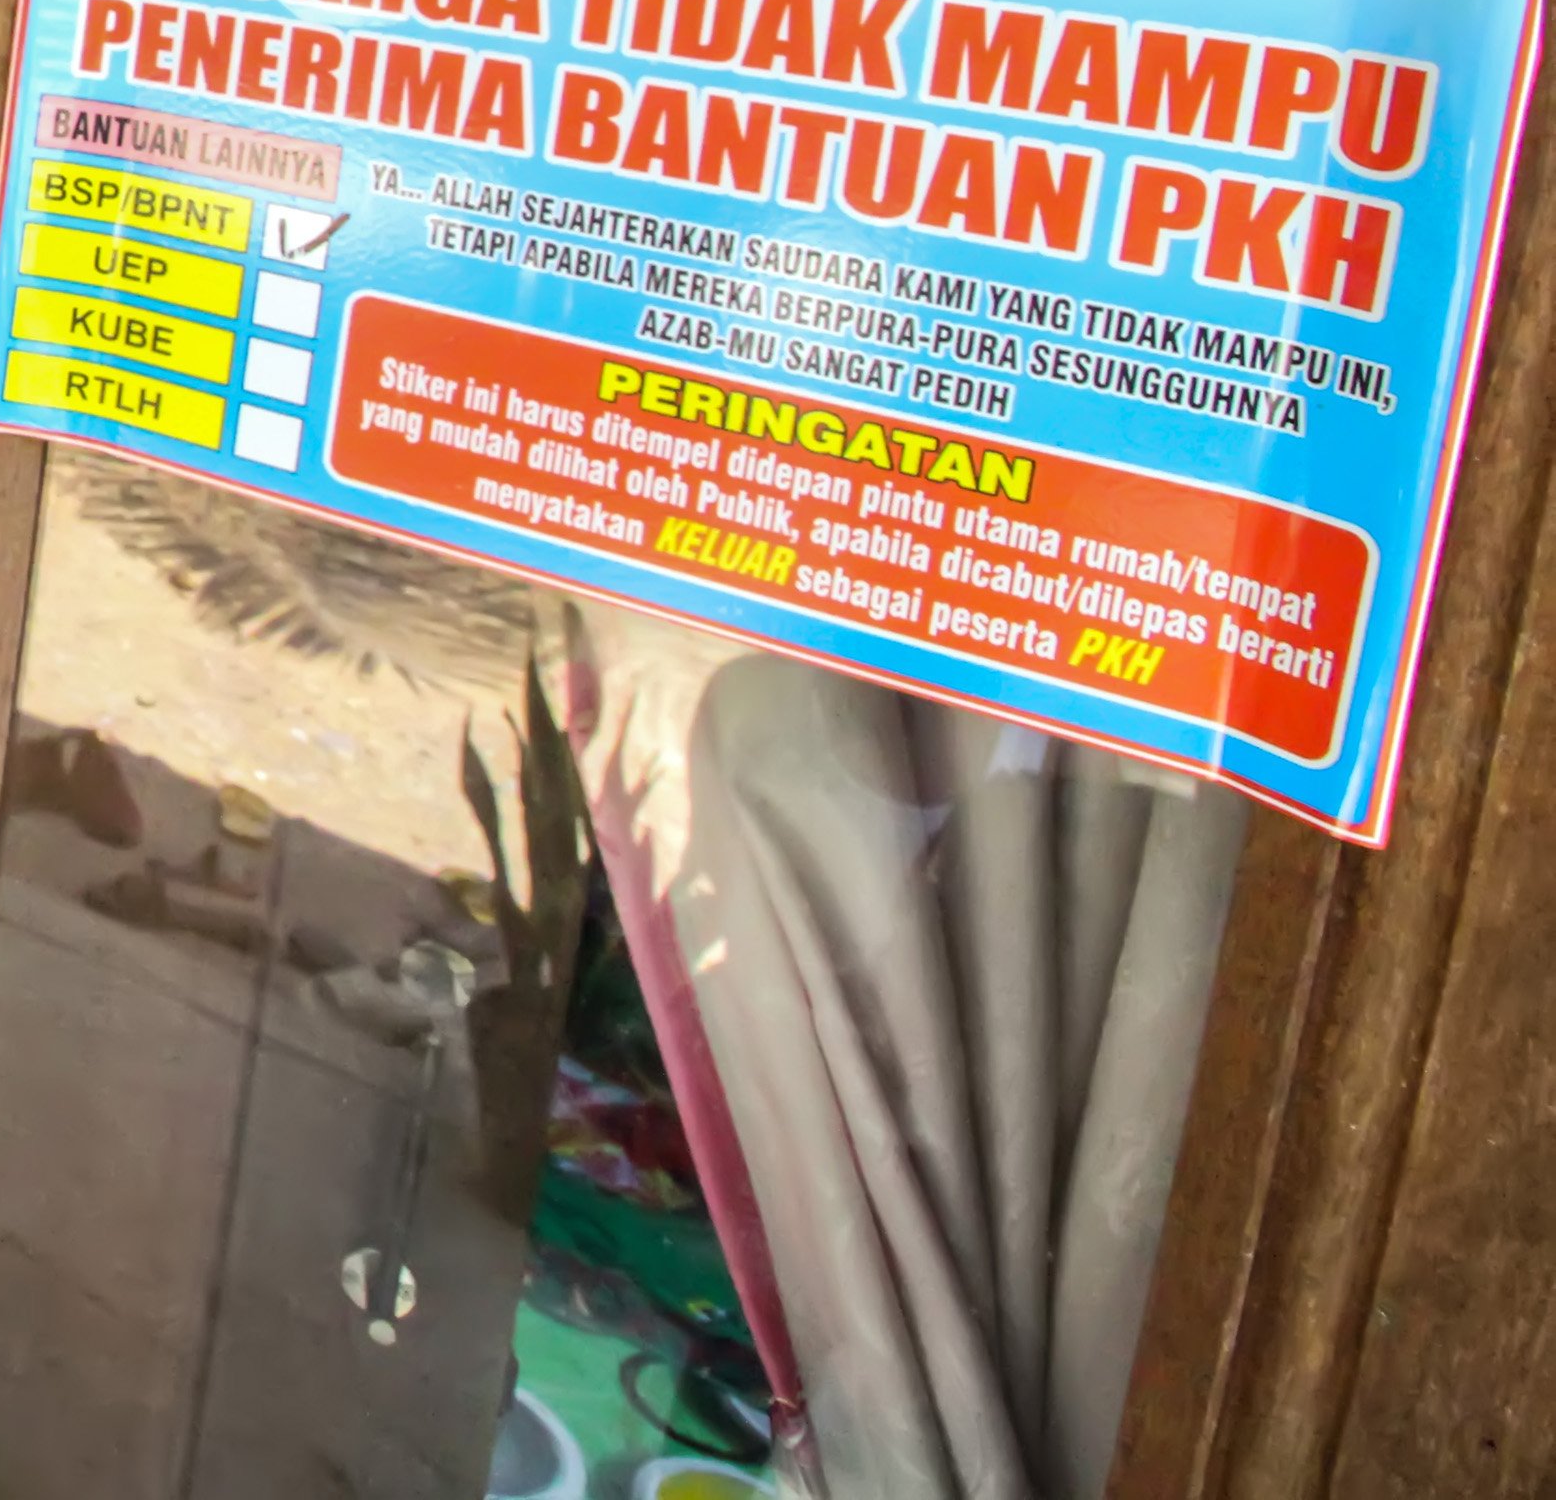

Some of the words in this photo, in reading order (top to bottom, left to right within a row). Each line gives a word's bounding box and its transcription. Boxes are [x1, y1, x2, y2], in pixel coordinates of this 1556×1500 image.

[53, 108, 189, 161] BANTUAN
[200, 134, 326, 190] LAINNYA
[929, 3, 1433, 175] MAMPU
[44, 173, 235, 233] BSP/BPNT
[92, 250, 168, 283] UEP
[554, 73, 1104, 253] BANTUAN
[1120, 172, 1393, 314] PKH
[70, 310, 174, 355] KUBE
[373, 164, 422, 199] YA...
[432, 178, 513, 216] ALLAH
[521, 195, 735, 261] SEJAHTERAKAN
[745, 238, 883, 292] SAUDARA
[895, 267, 976, 312] KAMI
[989, 285, 1071, 330] YANG
[1085, 304, 1183, 353] TIDAK
[1193, 327, 1329, 385] MAMPU
[1338, 356, 1392, 409] INI,
[428, 219, 514, 260] TETAPI
[523, 240, 634, 288] APABILA
[645, 265, 763, 315] MEREKA
[774, 291, 1018, 370] BERPURA-PURA
[1030, 346, 1301, 432] SESUNGGUHNYA
[641, 310, 776, 364] AZAB-MU
[787, 341, 904, 392] SANGAT
[911, 368, 1009, 417] PEDIH
[65, 373, 161, 420] RTLH
[598, 361, 1035, 502] PERINGATAN
[360, 399, 422, 443] yang
[430, 414, 520, 462] mudah
[528, 438, 619, 489] dilihat
[626, 467, 688, 509] oleh
[697, 480, 800, 544] Publik,
[810, 516, 929, 572] apabila
[940, 548, 1206, 645] dicabut/dilepas
[1218, 614, 1334, 689] berarti
[379, 357, 456, 405] Stiker
[464, 377, 499, 415] ini
[506, 388, 584, 437] harus
[593, 412, 719, 471] ditempel
[728, 445, 850, 505] didepan
[860, 482, 943, 528] pintu
[955, 507, 1059, 558] utama
[1070, 535, 1315, 630] rumah/tempat
[474, 477, 644, 545] menyatakan
[655, 516, 796, 586] KELUAR
[795, 564, 923, 622] sebagai
[929, 600, 1058, 660] peserta
[1069, 627, 1165, 685] PKH
